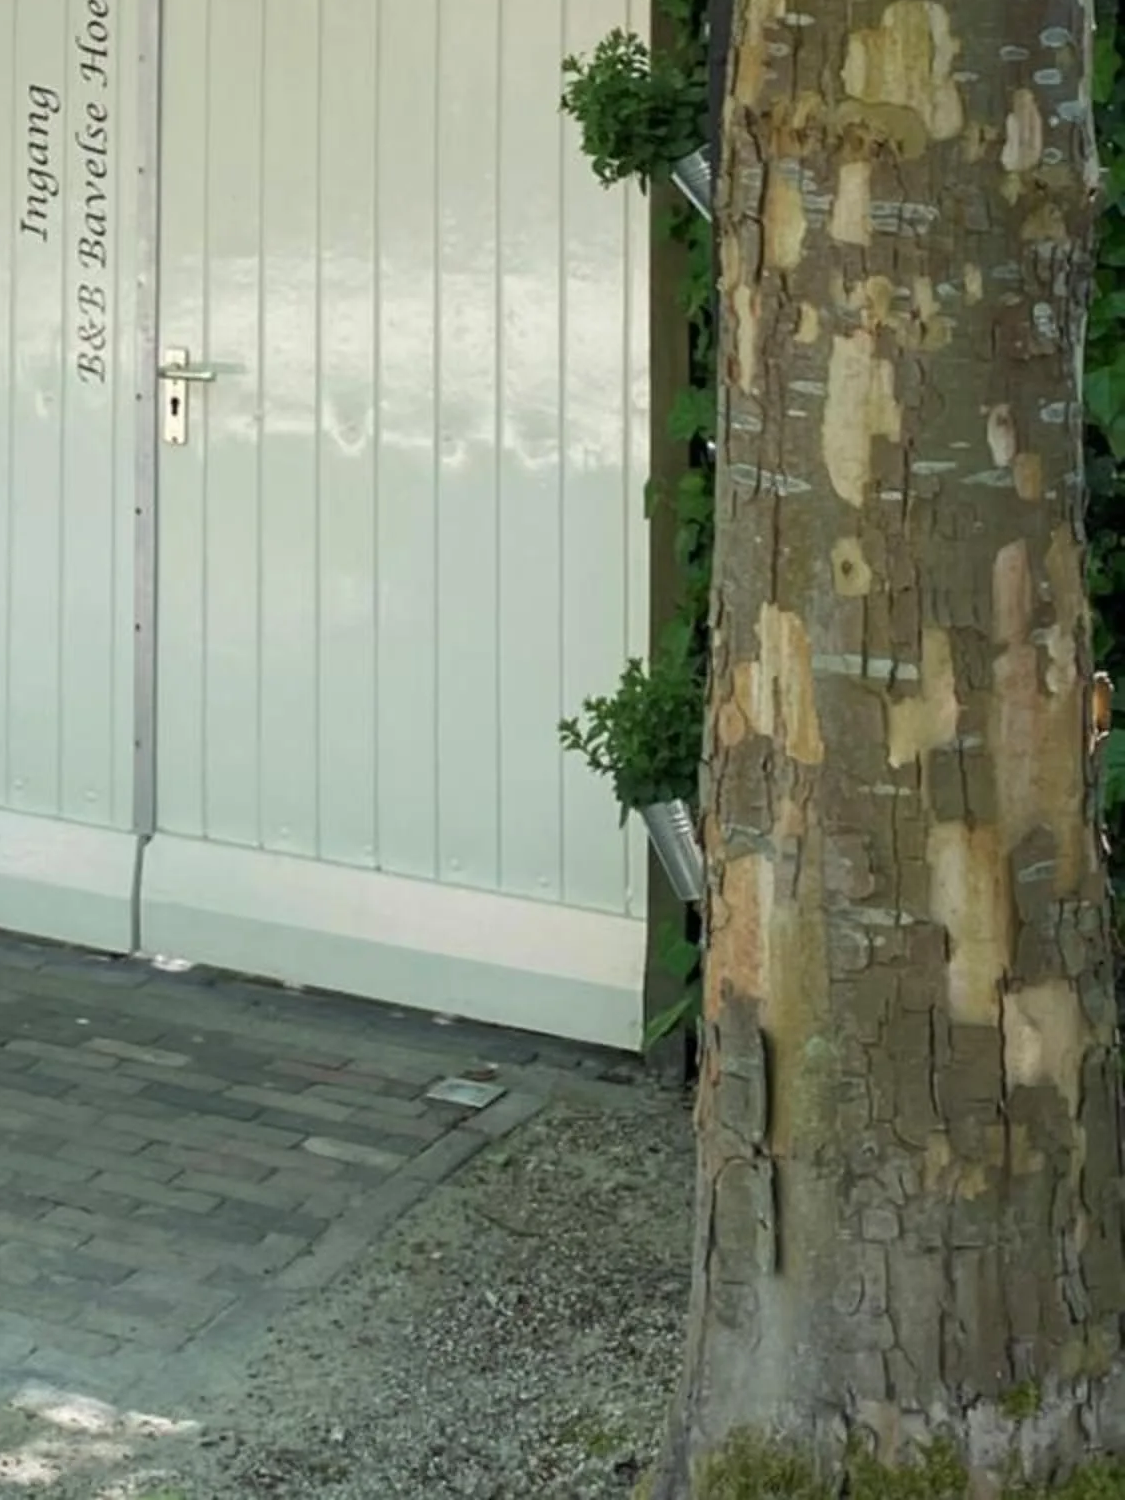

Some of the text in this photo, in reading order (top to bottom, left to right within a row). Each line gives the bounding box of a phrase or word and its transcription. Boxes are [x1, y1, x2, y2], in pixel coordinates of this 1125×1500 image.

[20, 84, 62, 242] Ingang
[75, 102, 109, 270] Bavelse
[76, 284, 107, 385] B&B
